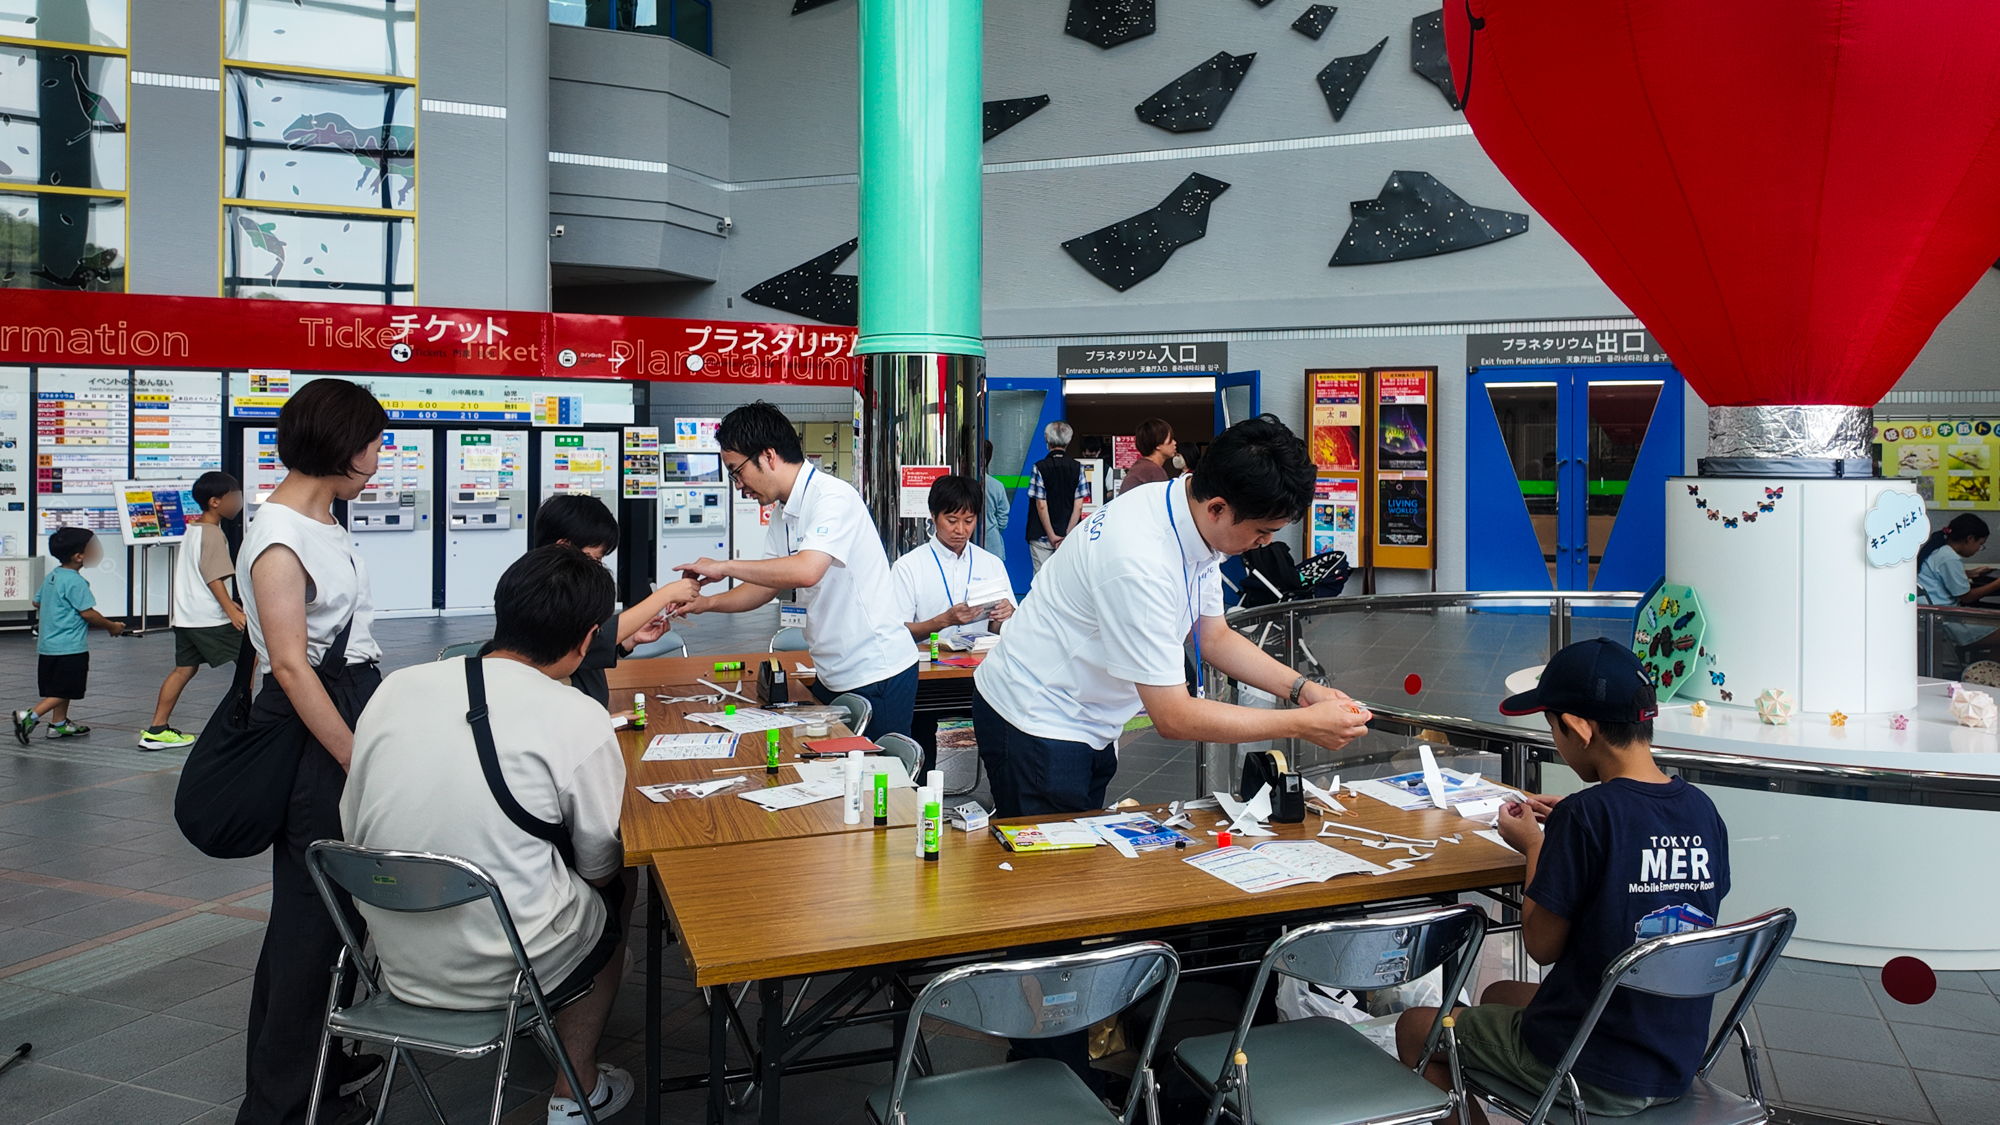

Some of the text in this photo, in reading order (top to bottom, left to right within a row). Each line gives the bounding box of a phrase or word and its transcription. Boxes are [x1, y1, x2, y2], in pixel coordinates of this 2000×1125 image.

[0, 321, 189, 357] rmation
[299, 317, 414, 350] Ticket
[390, 314, 508, 345] チケット
[415, 348, 447, 358] Tickets
[465, 341, 538, 362] Ticket
[1502, 331, 1645, 354] プラネタリウム出口
[611, 339, 849, 381] Planetarium
[1085, 345, 1198, 364] プラネタリウム入口
[1481, 356, 1561, 366] Exit from Planetarium
[1388, 499, 1418, 508] LIVING
[4, 566, 16, 597] 消毒液
[1650, 835, 1702, 848] TOKYO
[1640, 847, 1711, 882] MER
[1629, 882, 1659, 893] Mobile
[1660, 881, 1699, 892] Emergency
[550, 1104, 565, 1112] NIKE
